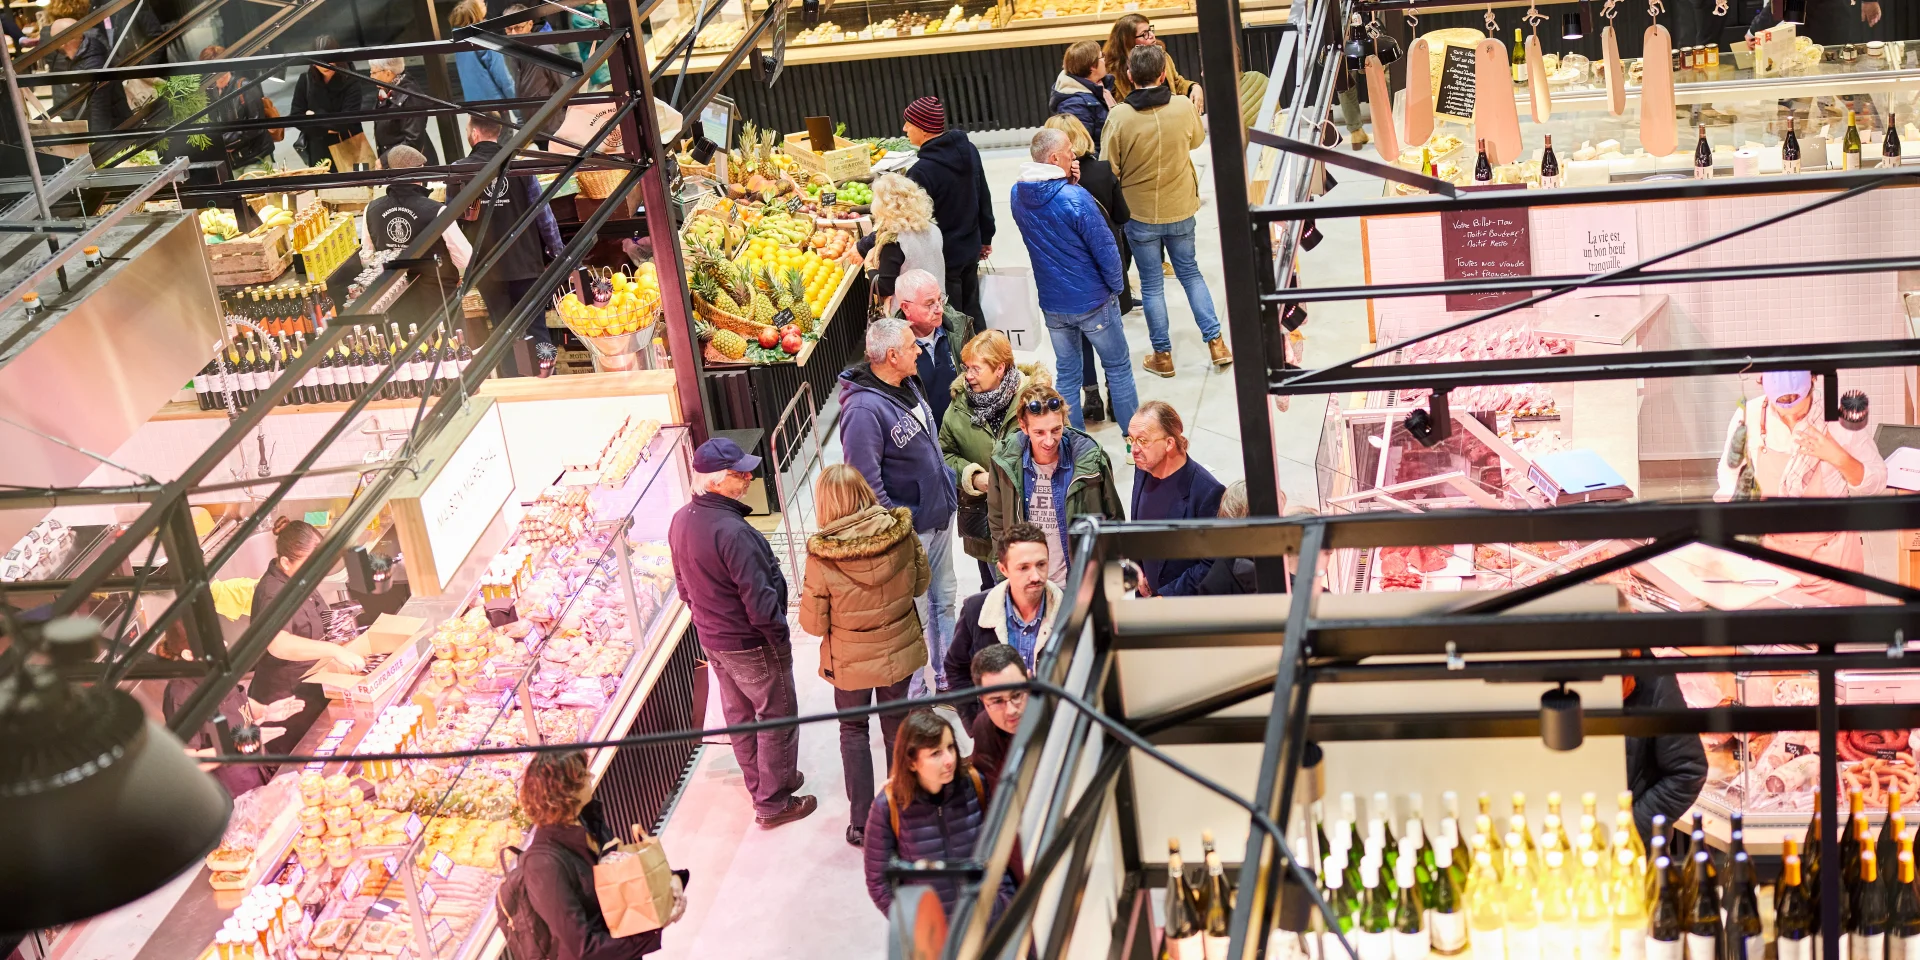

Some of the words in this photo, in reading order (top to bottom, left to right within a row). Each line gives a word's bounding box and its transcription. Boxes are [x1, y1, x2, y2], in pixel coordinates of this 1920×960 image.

[589, 110, 607, 127] MAISON
[1588, 231, 1597, 244] La
[1599, 230, 1608, 243] vie
[1610, 232, 1620, 241] est
[1583, 249, 1592, 257] un
[1594, 245, 1606, 257] bon
[1608, 242, 1626, 255] bœuf
[1455, 257, 1478, 267] Toutes
[1589, 256, 1622, 274] tranquille.
[1035, 486, 1053, 494] 1993
